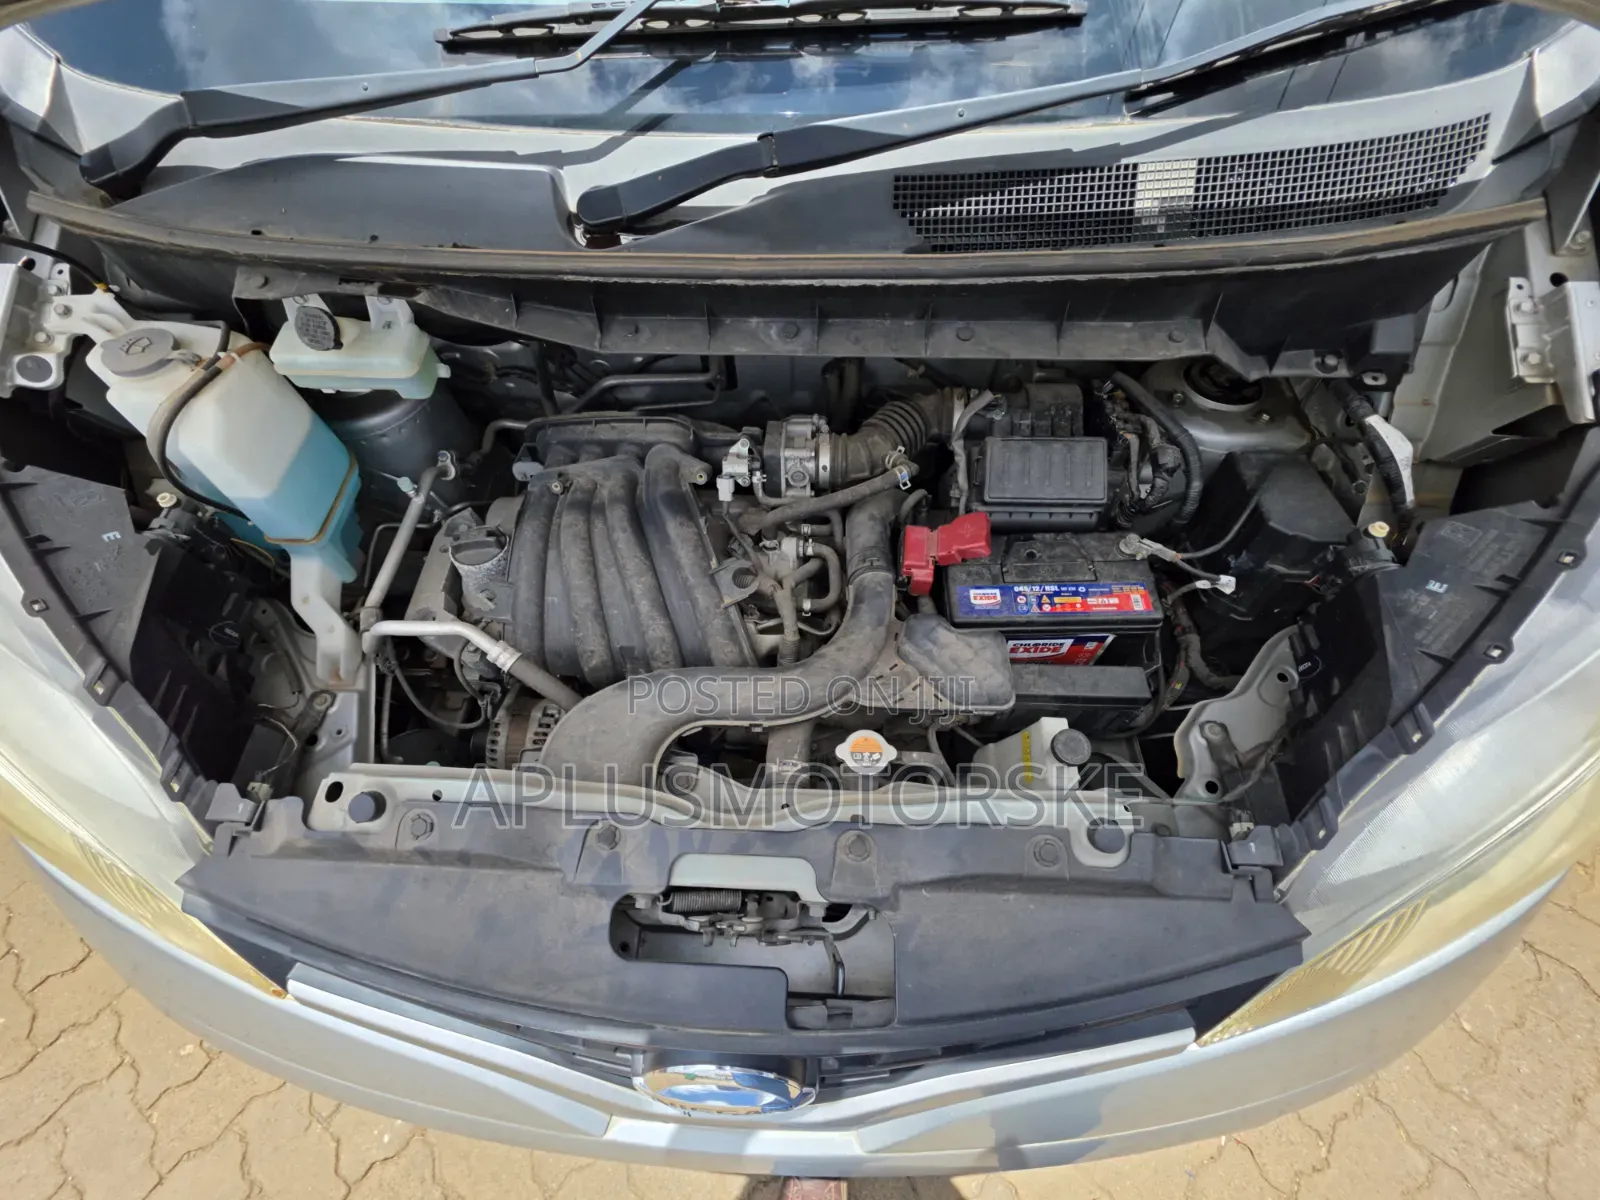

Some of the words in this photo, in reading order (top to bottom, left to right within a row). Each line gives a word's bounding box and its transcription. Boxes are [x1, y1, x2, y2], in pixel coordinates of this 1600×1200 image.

[102, 531, 121, 542] E
[1425, 579, 1448, 593] E
[1009, 646, 1063, 654] EXIDE
